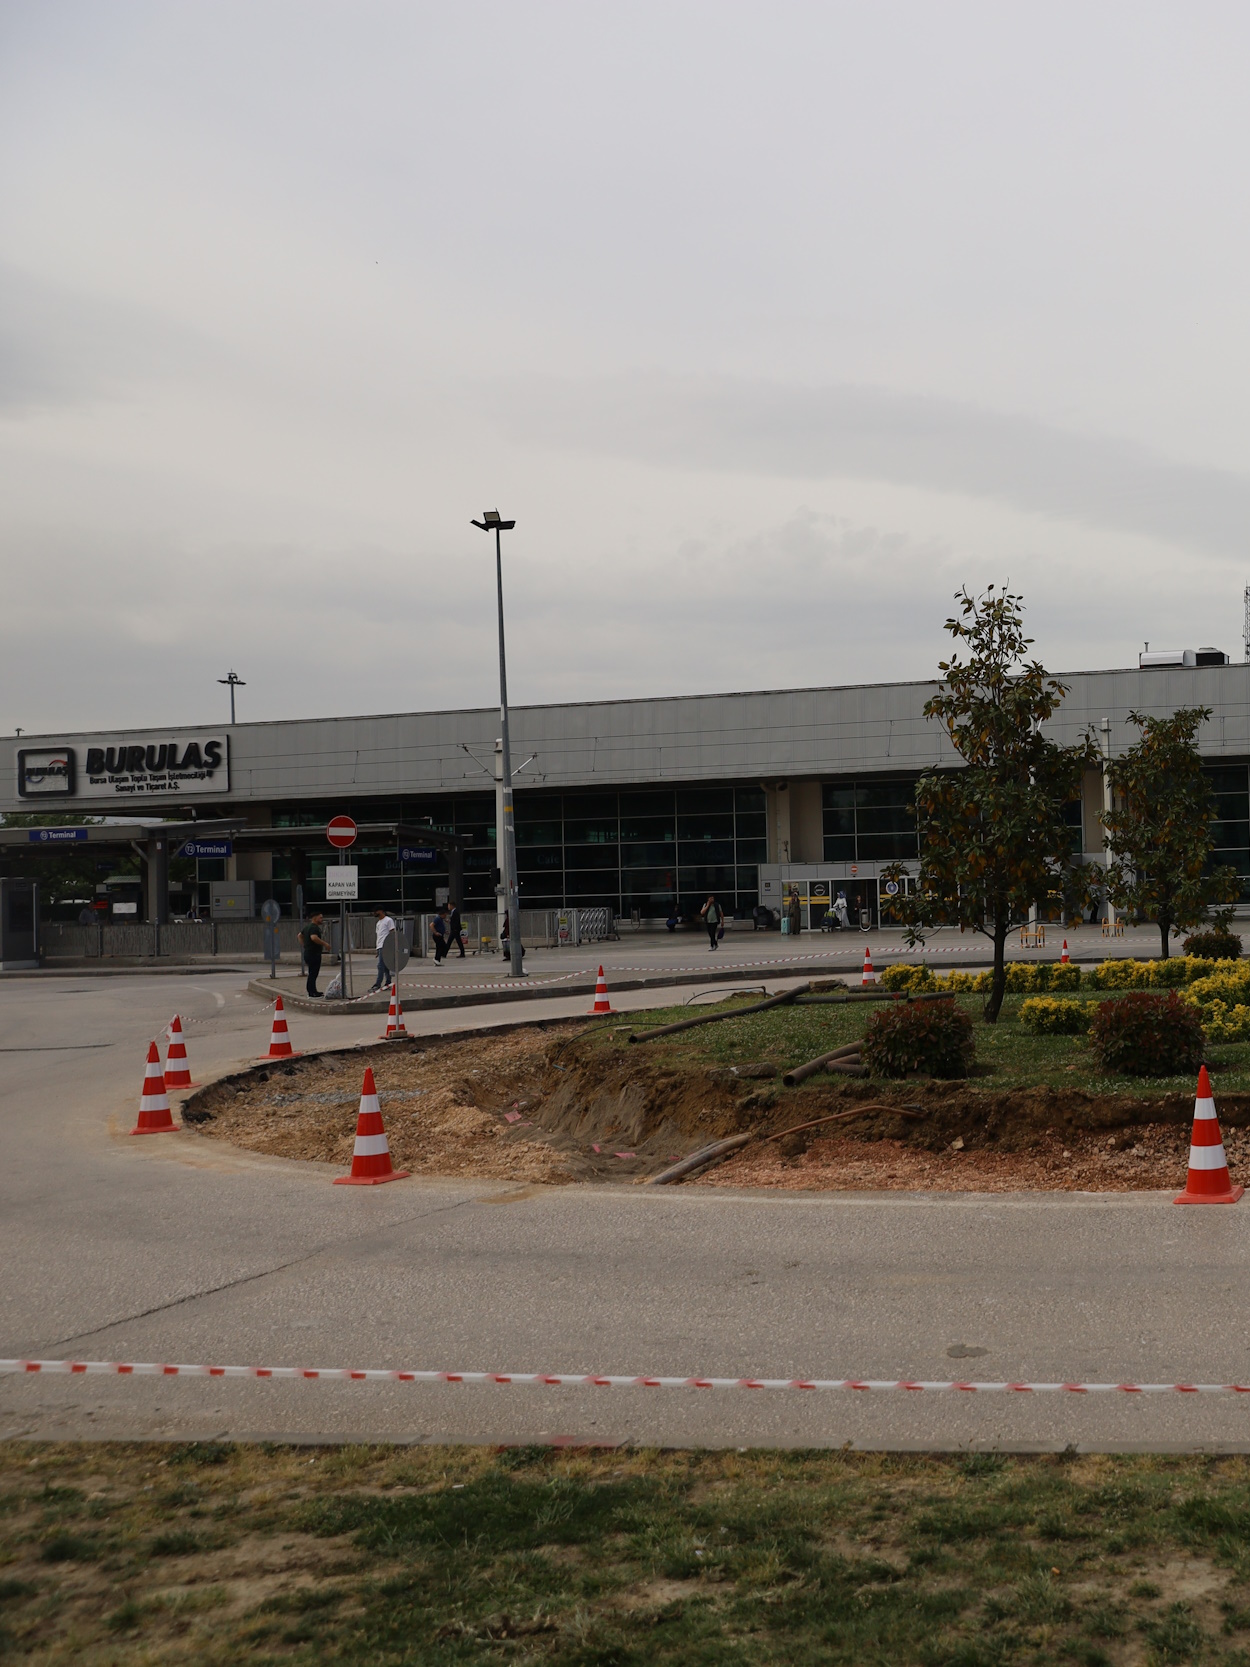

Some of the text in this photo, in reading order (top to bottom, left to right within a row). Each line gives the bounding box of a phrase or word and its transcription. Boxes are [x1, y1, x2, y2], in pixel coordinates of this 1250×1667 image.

[90, 776, 107, 784] Bursa
[196, 845, 227, 854] Terminal
[410, 850, 432, 858] Terminal
